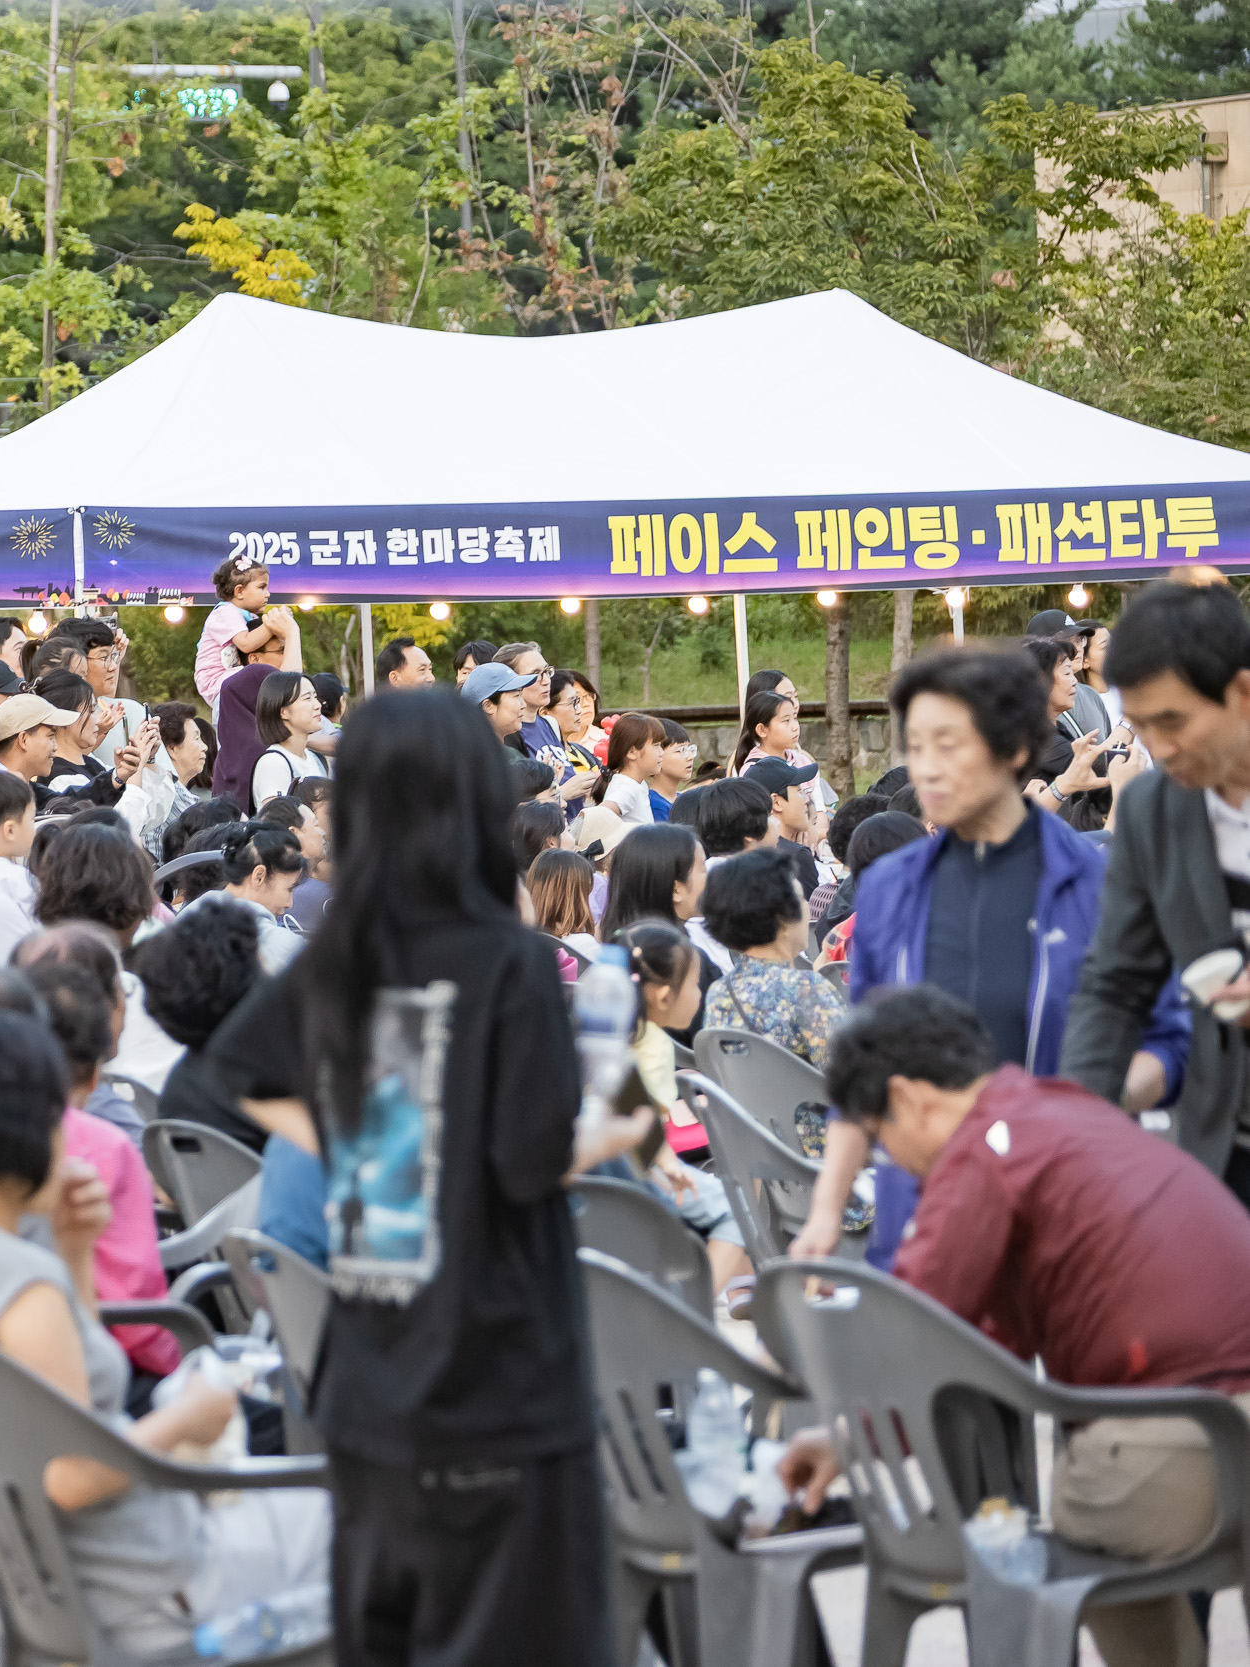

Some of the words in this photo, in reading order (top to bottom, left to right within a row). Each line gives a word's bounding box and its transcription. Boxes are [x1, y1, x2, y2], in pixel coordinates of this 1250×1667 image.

[228, 531, 301, 566] 2025
[308, 529, 378, 566] 군자
[386, 525, 561, 566] 한마당축제
[607, 512, 778, 577] 페이스
